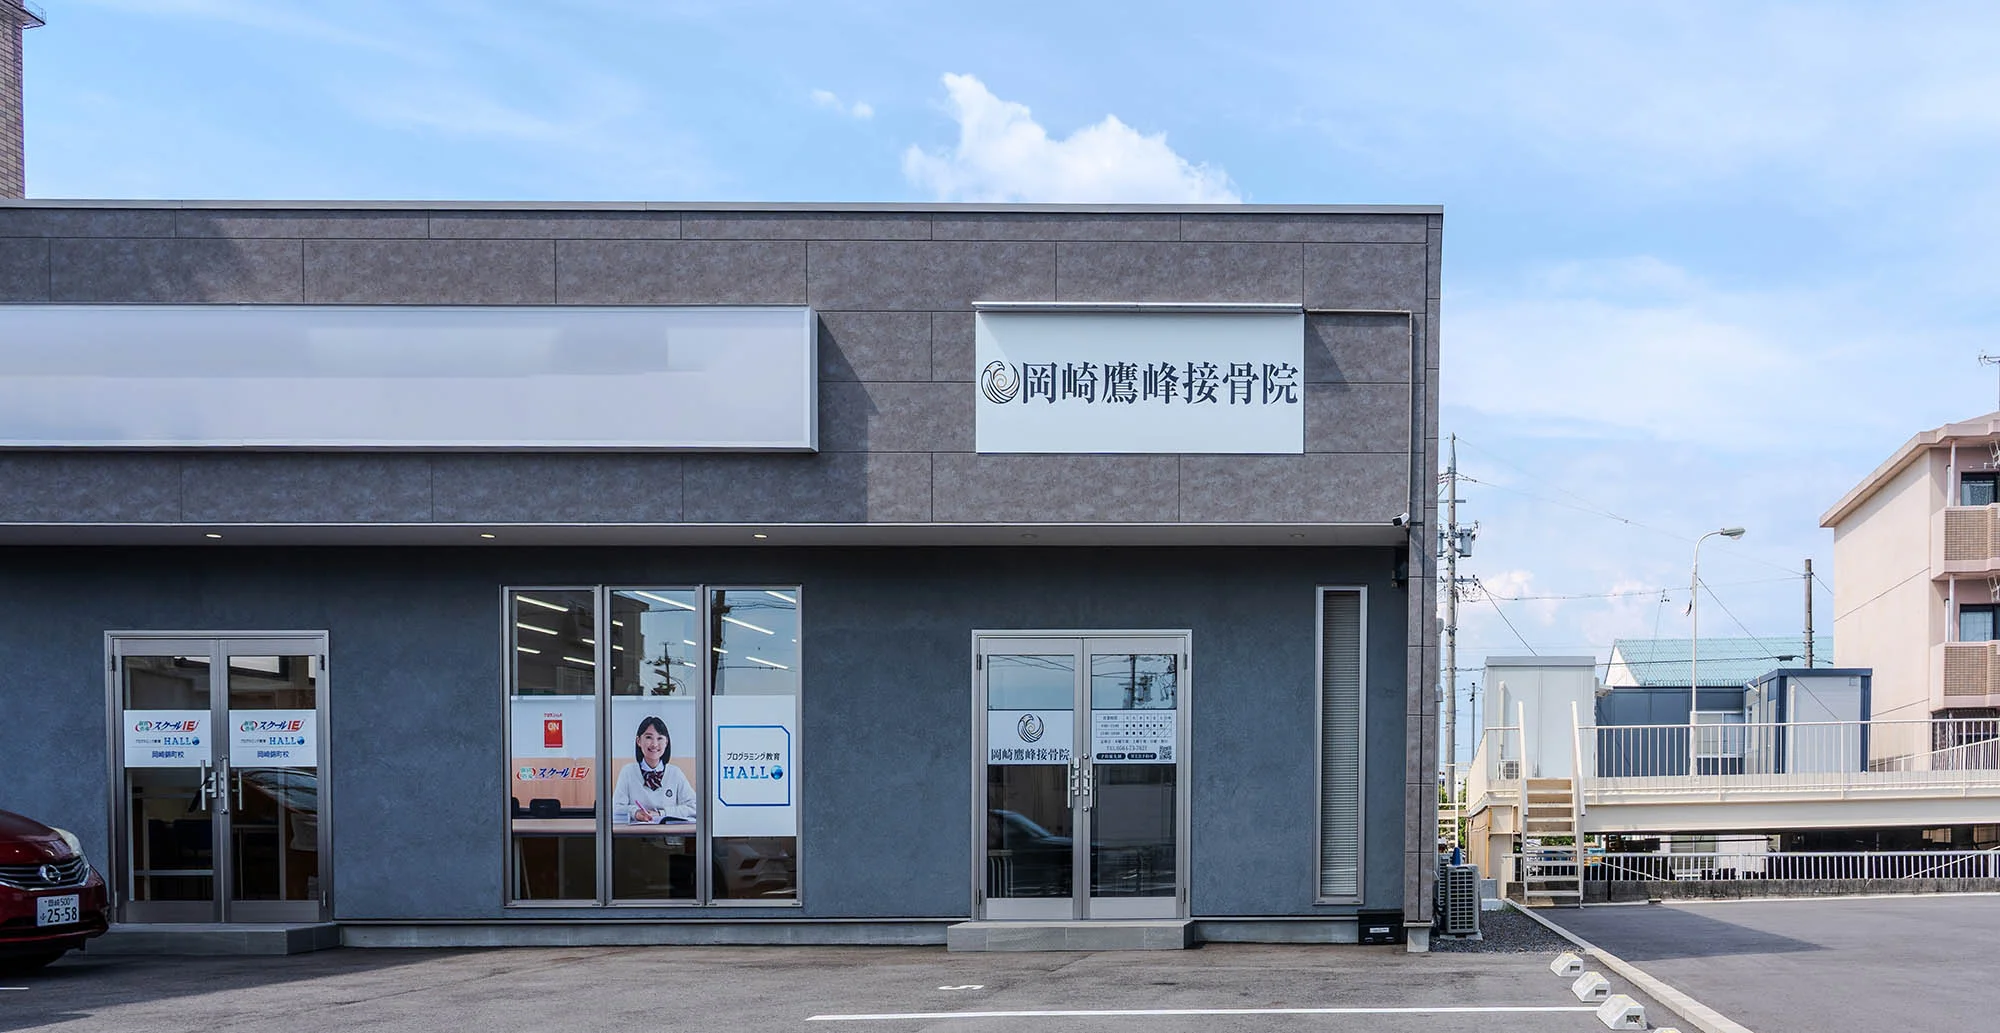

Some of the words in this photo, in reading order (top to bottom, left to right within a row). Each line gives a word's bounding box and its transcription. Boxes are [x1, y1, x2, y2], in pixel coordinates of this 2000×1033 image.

[1022, 361, 1299, 405] 岡崎鷹峰接骨院
[727, 752, 780, 761] プログラミング教育
[47, 907, 77, 923] 25-58
